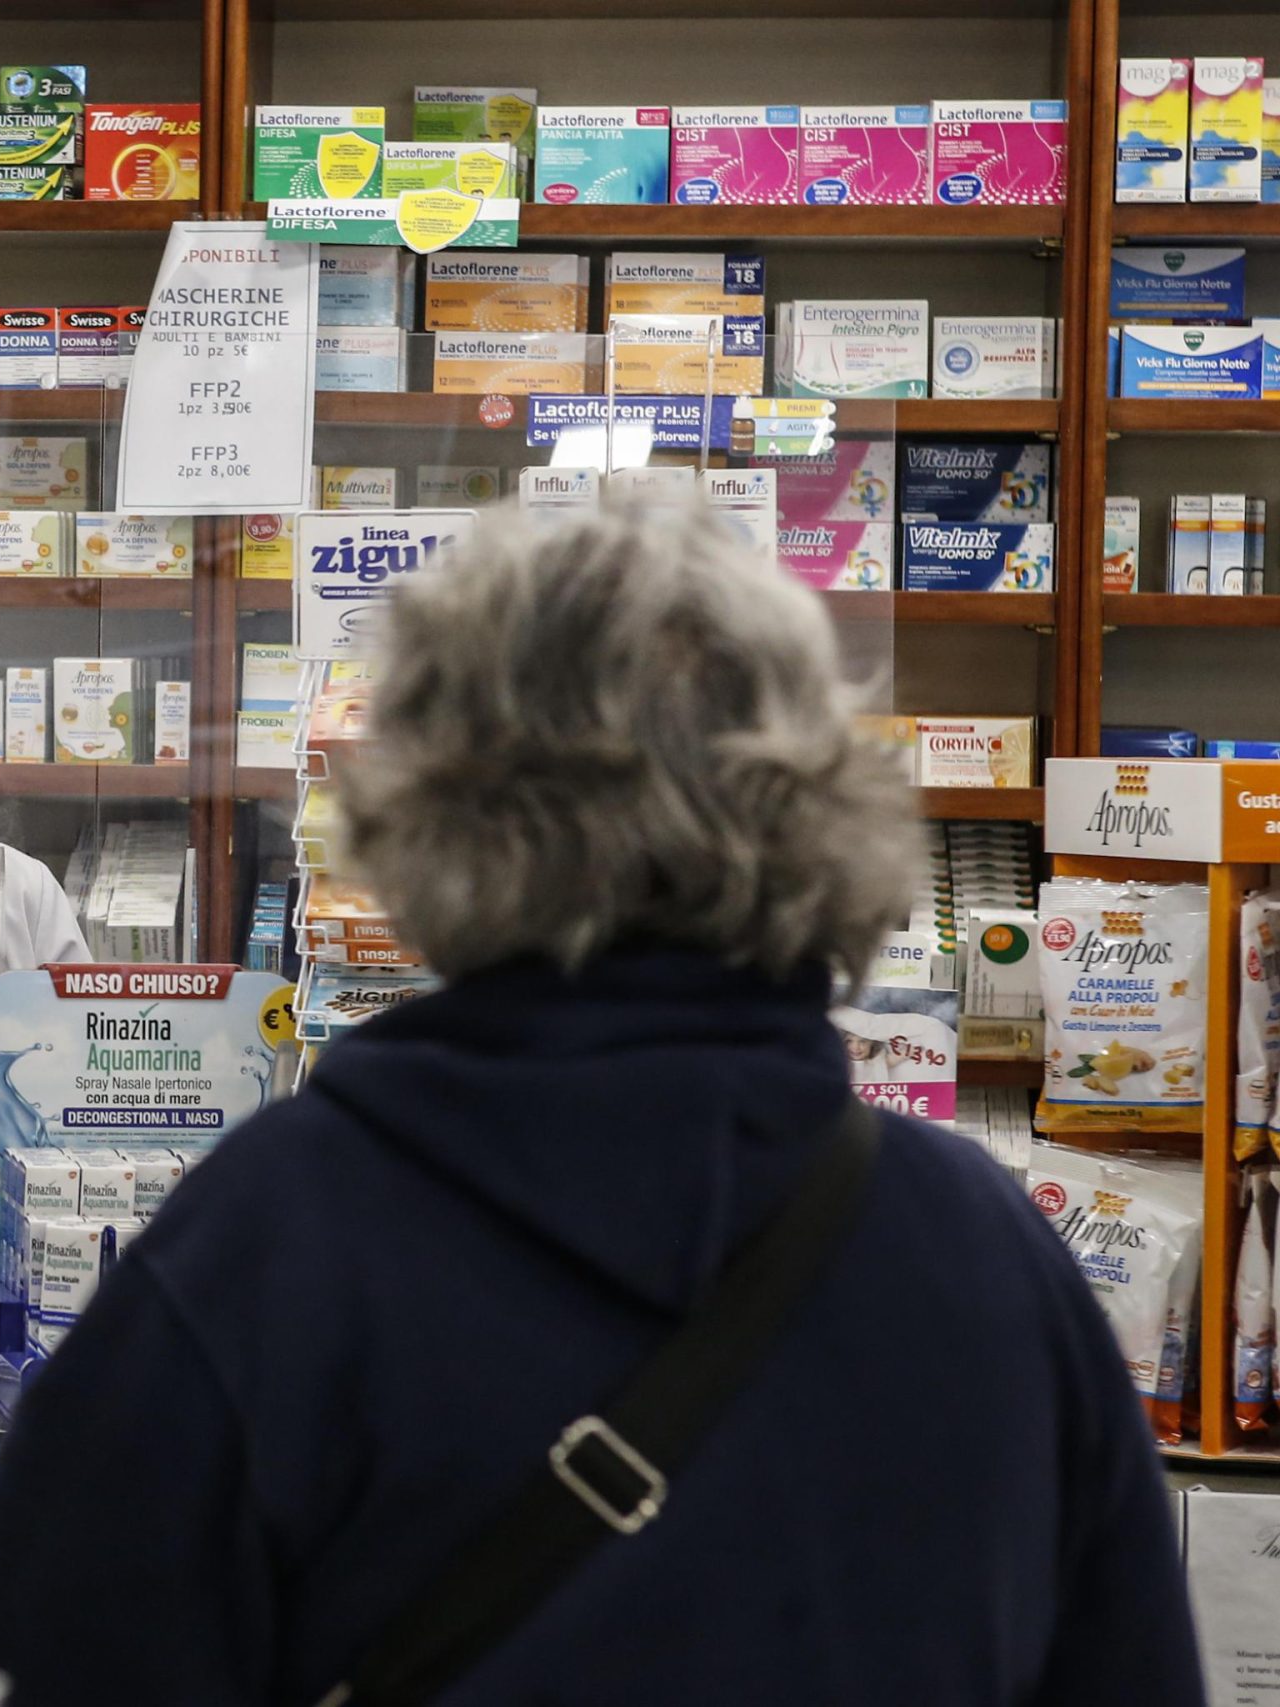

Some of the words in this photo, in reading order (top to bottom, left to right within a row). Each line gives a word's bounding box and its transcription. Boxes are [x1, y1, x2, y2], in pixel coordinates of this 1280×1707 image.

[1127, 66, 1165, 83] mag
[1201, 65, 1239, 82] mag
[418, 92, 484, 103] Lactoflorene
[260, 113, 341, 126] Lactoflorene
[677, 113, 759, 125] Lactoflorene
[805, 113, 888, 125] Lactoflorene
[939, 108, 1023, 121] Lactoflorene
[90, 112, 163, 135] Tonogen
[159, 121, 200, 135] PLUS
[543, 115, 624, 127] Lactoflorene
[259, 129, 296, 138] DIFESA
[542, 130, 582, 139] PANCIA
[585, 130, 624, 139] PIATTA
[676, 130, 708, 142] CIST
[805, 130, 836, 142] CIST
[938, 124, 971, 137] CIST
[387, 148, 456, 160] Lactoflorene
[273, 205, 387, 218] Lactoflorene
[272, 219, 337, 230] DIFESA
[432, 263, 518, 275] Lactoflorene
[616, 265, 694, 277] Lactoflorene
[735, 270, 756, 283] 18
[1117, 279, 1142, 288] Vicks
[1145, 279, 1160, 288] Flu
[1163, 279, 1198, 289] Giorno
[1201, 280, 1231, 289] Notte
[4, 315, 45, 326] Swisse
[70, 315, 111, 326] Swisse
[150, 311, 289, 326] CHIRURGICHE
[804, 306, 919, 323] Enterogermina
[832, 324, 884, 336] Intestino
[888, 324, 919, 338] Pigro
[941, 322, 1036, 337] Enterogermina
[0, 336, 49, 347] DONNA
[62, 338, 97, 346] DONNA
[152, 332, 199, 342] ADULTI
[209, 333, 215, 342] E
[225, 333, 281, 342] BAMBINI
[734, 332, 754, 344] 18
[183, 346, 199, 356] 10
[208, 347, 224, 358] pz
[234, 346, 248, 356] 5€
[440, 341, 526, 353] Lactoflorene
[1137, 358, 1163, 368] Vicks
[1165, 358, 1180, 367] Flu
[1183, 359, 1217, 369] Giorno
[1220, 360, 1250, 369] Notte
[190, 380, 241, 398] FFP2
[179, 403, 203, 415] 1pz
[534, 402, 656, 418] Lactoflorene
[663, 407, 700, 418] PLUS
[787, 404, 816, 413] PREMI
[787, 423, 816, 432] AGITA
[192, 444, 238, 461] FFP3
[908, 449, 997, 468] Vitalmix
[178, 465, 201, 478] 2pz
[211, 465, 251, 478] 8,00€
[936, 469, 971, 478] UOMO
[326, 480, 385, 494] Multivita
[534, 477, 591, 492] Influvis
[712, 480, 769, 496] Influvis
[362, 526, 409, 540] linea
[909, 527, 1001, 548] Vitalmix
[938, 550, 974, 559] UOMO
[246, 650, 288, 658] FROBEN
[240, 718, 283, 727] FROBEN
[929, 735, 985, 752] CORYFIN
[1086, 789, 1170, 847] Apropos
[1061, 930, 1172, 974] Apropos
[66, 974, 123, 993] NASO
[129, 974, 219, 995] CHIUSO?
[1078, 978, 1154, 990] CARAMELLE
[1068, 991, 1102, 1003] ALLA
[1106, 993, 1159, 1003] PROPOLI
[87, 1003, 171, 1041] Rinazina
[1063, 1020, 1087, 1031] Gusto
[1090, 1021, 1120, 1031] Limone
[87, 1043, 201, 1076] Aquamarina
[76, 1077, 108, 1091] Spray
[112, 1077, 151, 1090] Nasale
[155, 1077, 211, 1091] Ipertonico
[866, 1086, 876, 1094] A
[880, 1085, 907, 1094] SOLI
[86, 1094, 108, 1104] con
[112, 1094, 150, 1106] acqua
[155, 1093, 165, 1104] di
[170, 1094, 201, 1105] mare
[68, 1112, 169, 1124] DECONGESTIONA
[172, 1112, 182, 1124] IL
[186, 1112, 219, 1124] NASO
[27, 1181, 61, 1196] Rinazina
[84, 1182, 117, 1197] Rinazina
[27, 1197, 72, 1209] Aquamarina
[47, 1242, 81, 1258] Rinazina
